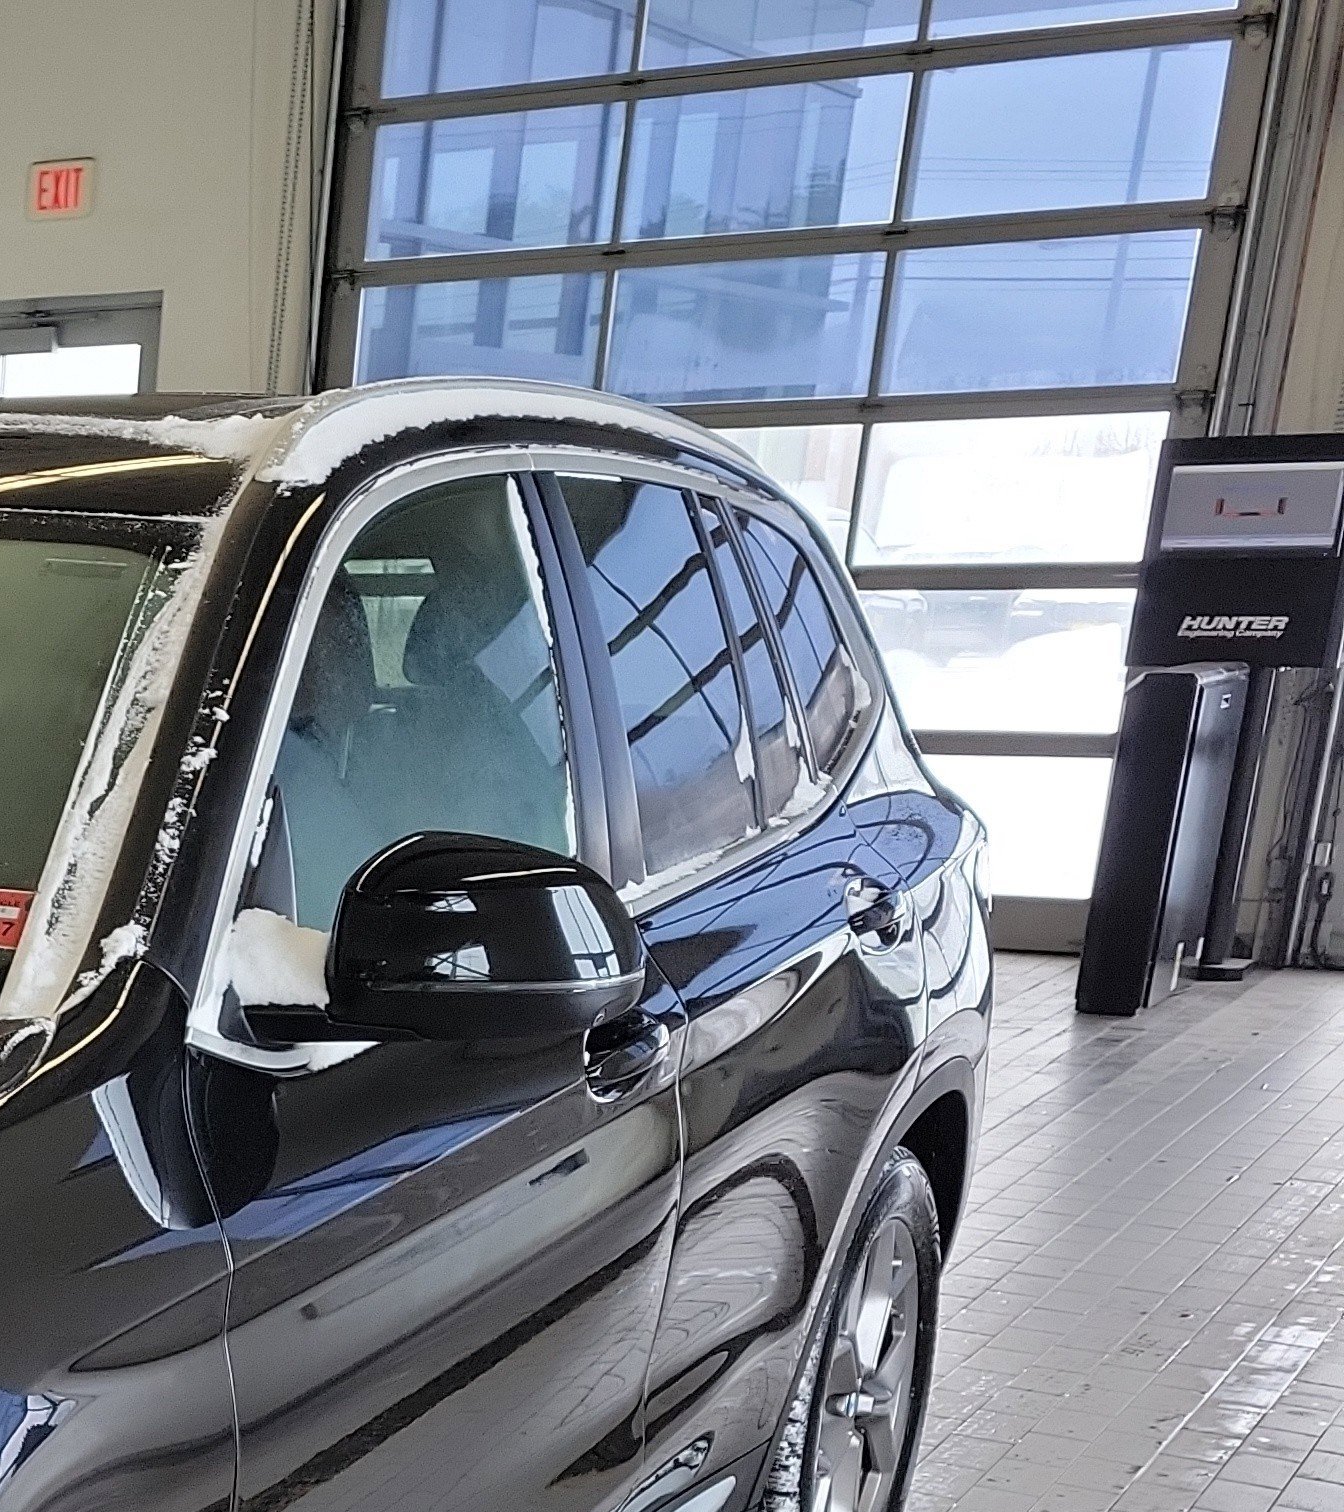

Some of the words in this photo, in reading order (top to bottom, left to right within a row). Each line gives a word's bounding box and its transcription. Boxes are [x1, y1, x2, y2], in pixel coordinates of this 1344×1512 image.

[37, 167, 84, 211] EXIT
[1181, 615, 1290, 630] HUNTER
[1177, 629, 1235, 638] Engineering
[1235, 630, 1284, 639] Company
